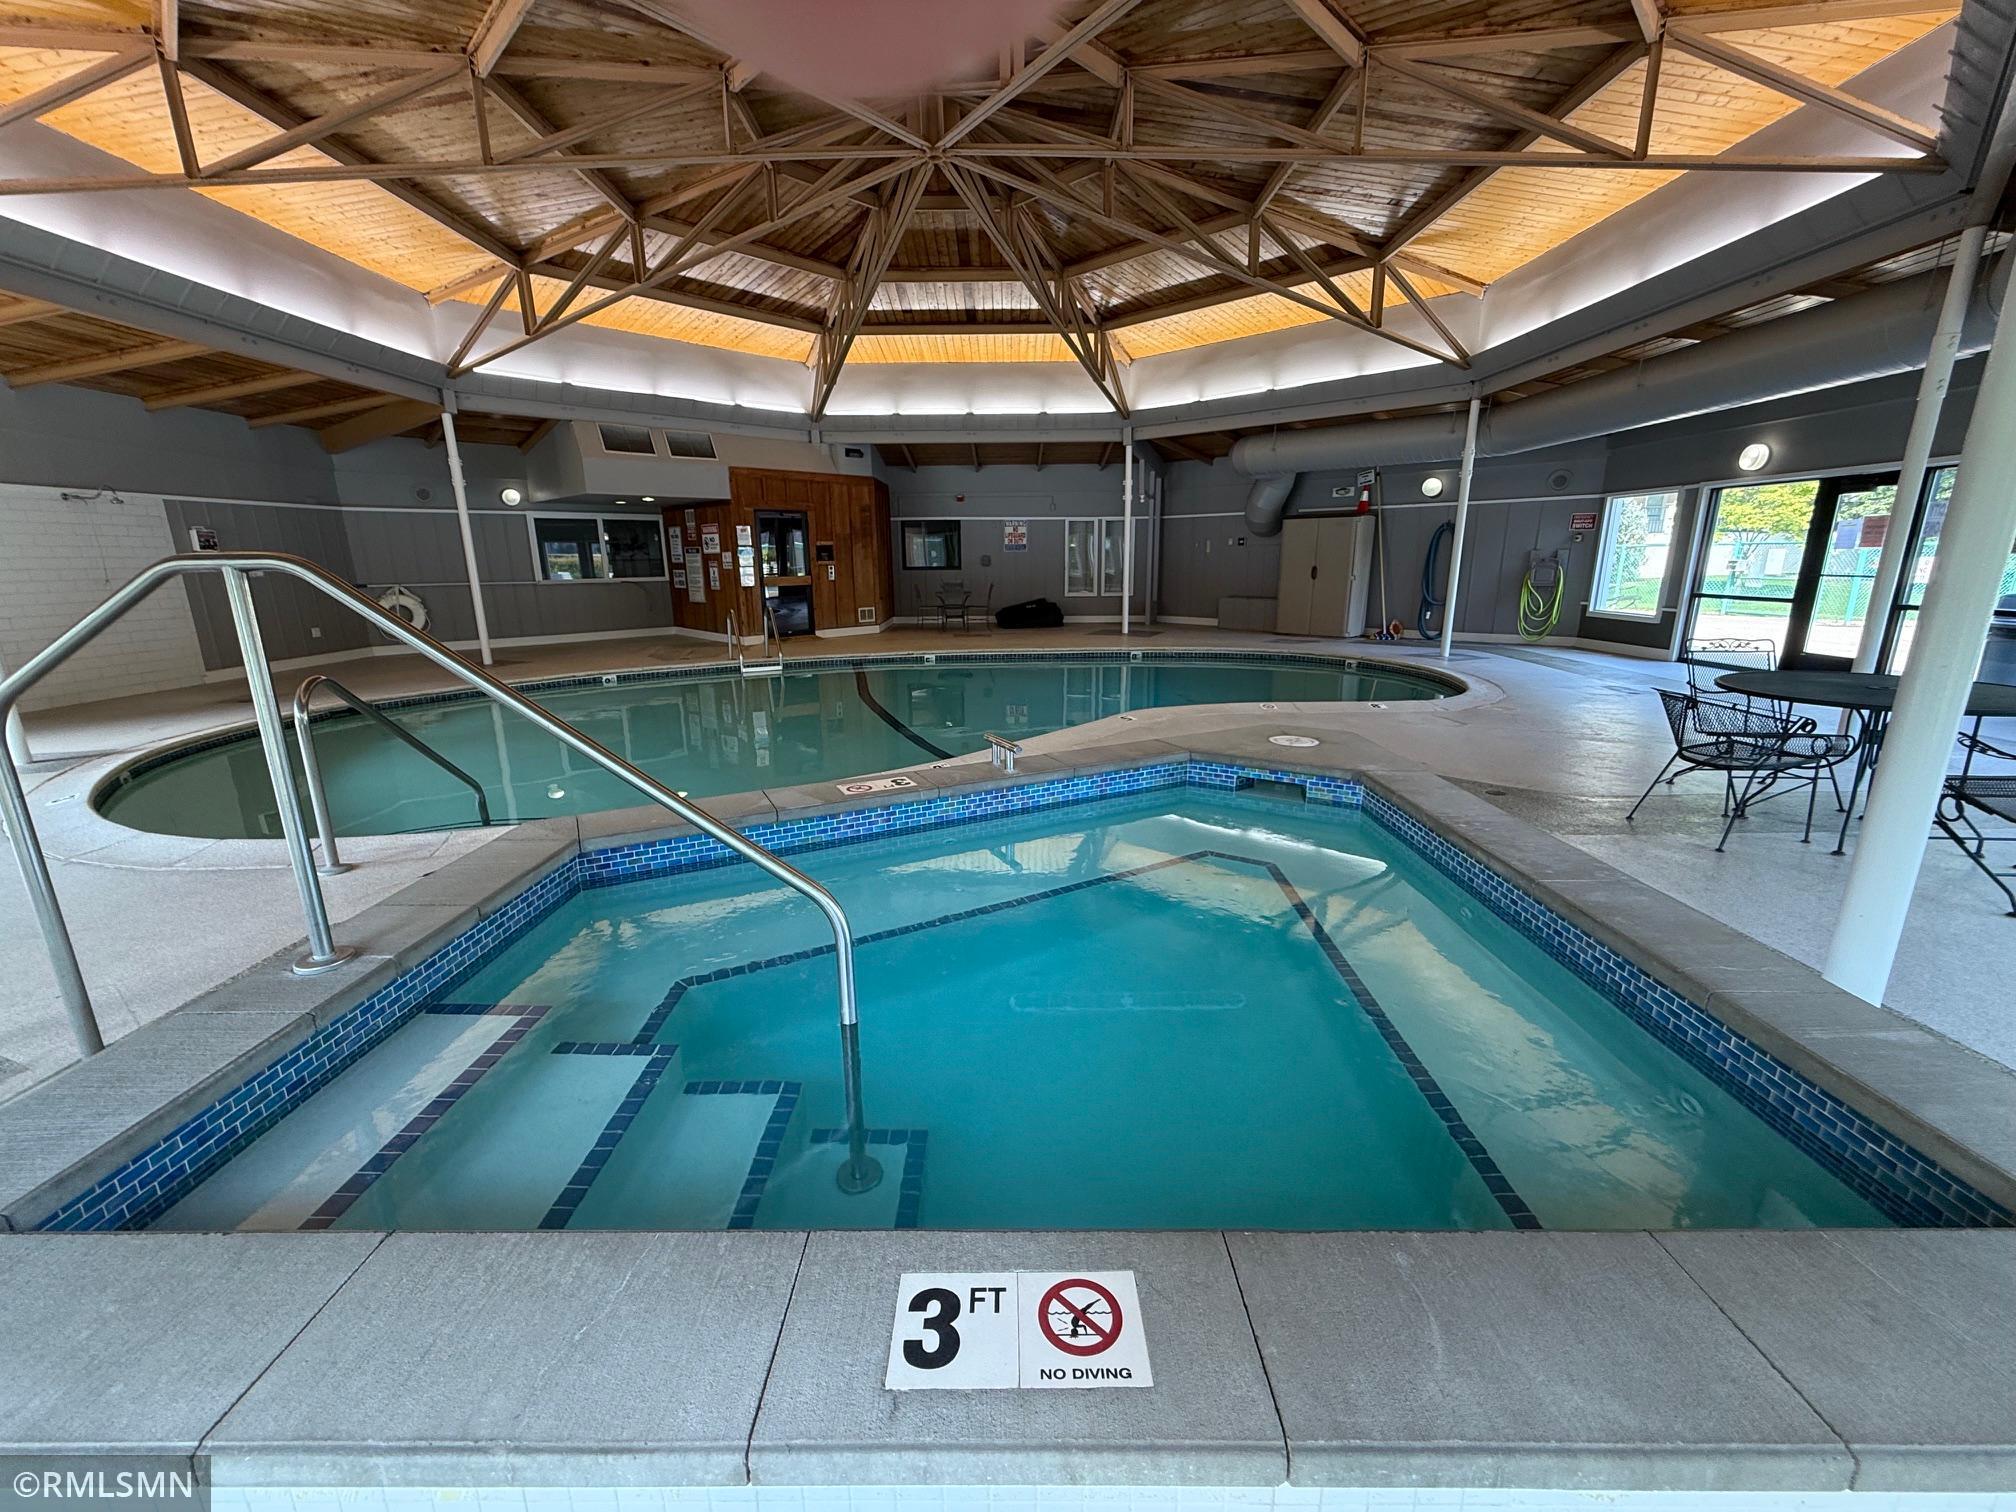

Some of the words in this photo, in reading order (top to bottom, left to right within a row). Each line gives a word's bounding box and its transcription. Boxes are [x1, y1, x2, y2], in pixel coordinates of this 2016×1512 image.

[903, 1287, 961, 1370] 3
[969, 1287, 1007, 1314] FT
[1040, 1368, 1066, 1380] NO
[1072, 1367, 1133, 1380] DIVING
